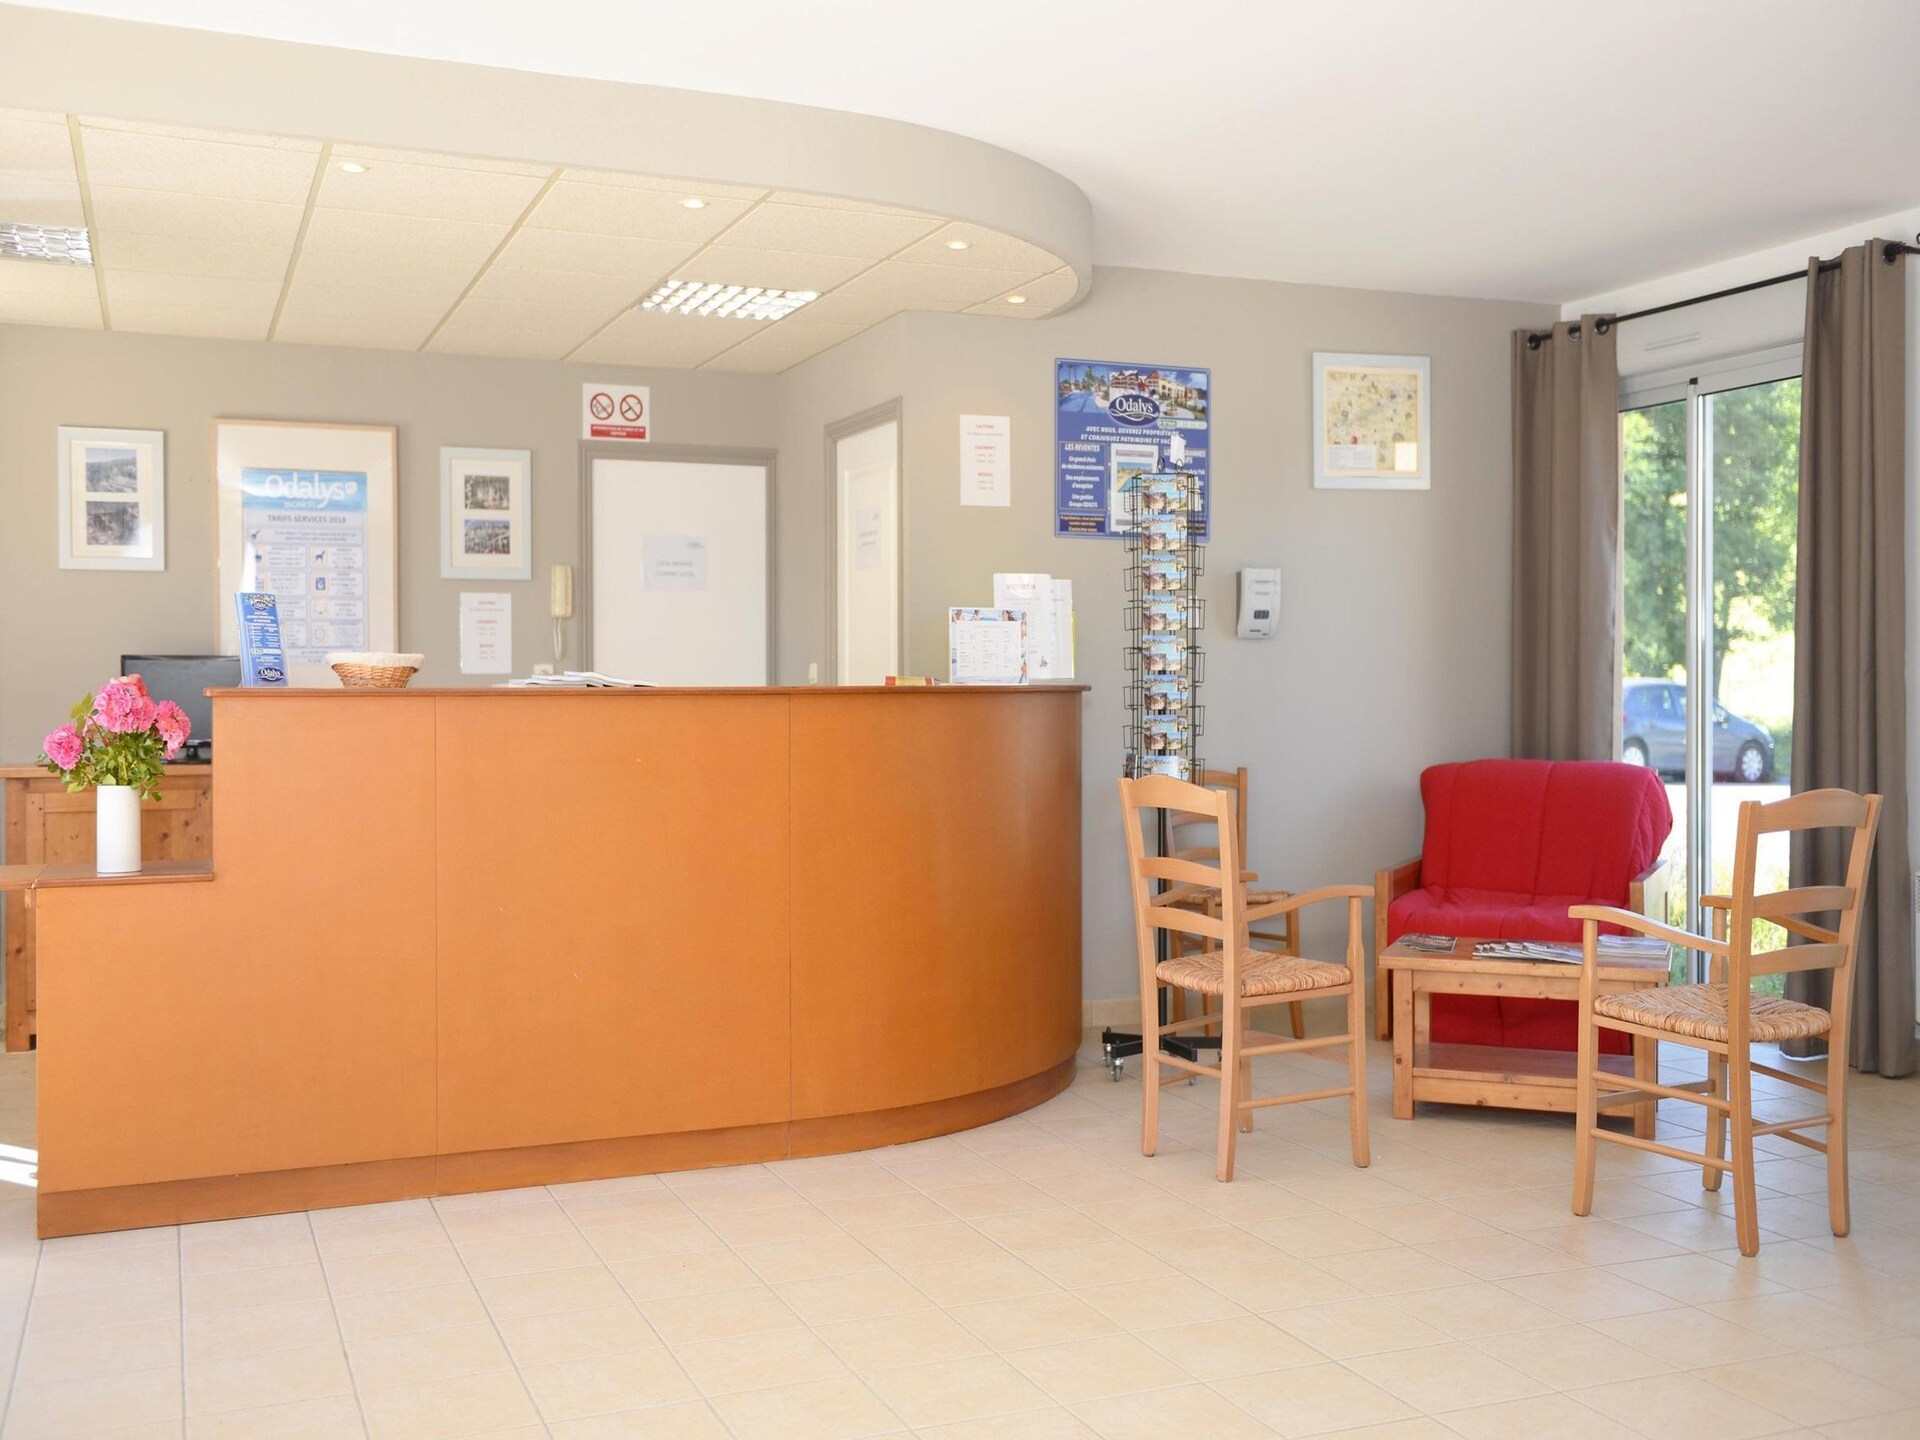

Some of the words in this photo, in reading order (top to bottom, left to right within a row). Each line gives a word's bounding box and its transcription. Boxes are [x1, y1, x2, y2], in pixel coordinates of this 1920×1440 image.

[1116, 397, 1154, 414] Odalys
[1088, 434, 1120, 442] CONJUGUEZ
[1075, 444, 1100, 452] REVENTES
[264, 472, 346, 508] Odalys
[268, 515, 293, 523] TARIFS
[294, 515, 327, 524] SERVICES
[329, 516, 347, 524] 2018
